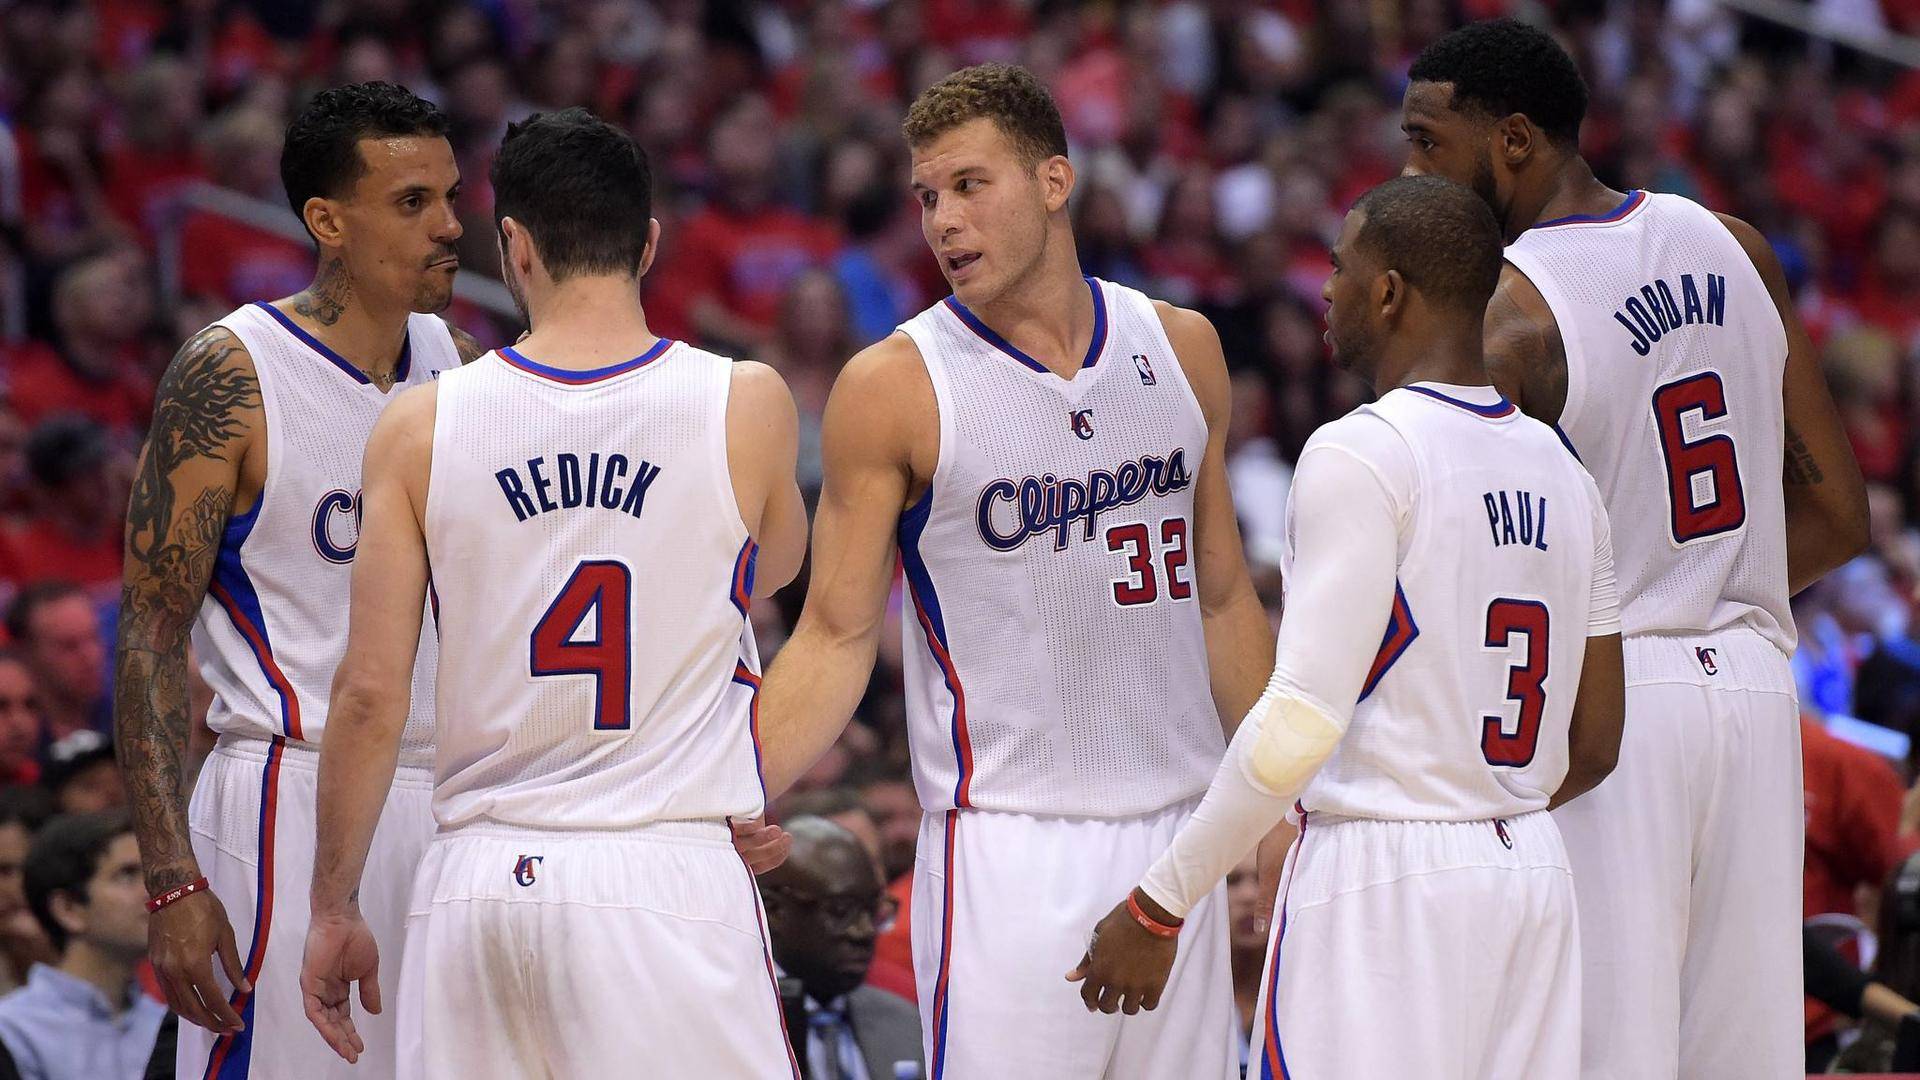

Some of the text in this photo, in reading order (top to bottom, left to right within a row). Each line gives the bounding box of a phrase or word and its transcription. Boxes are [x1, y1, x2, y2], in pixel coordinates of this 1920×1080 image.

[1613, 273, 1726, 357] JORDAN
[495, 453, 661, 523] REDICK
[975, 447, 1192, 553] Clippers
[1651, 371, 1746, 544] 6
[311, 489, 363, 565] C
[1106, 517, 1191, 606] 32
[1483, 490, 1549, 552] PAUL
[530, 560, 632, 731] 4
[1480, 597, 1550, 768] 3
